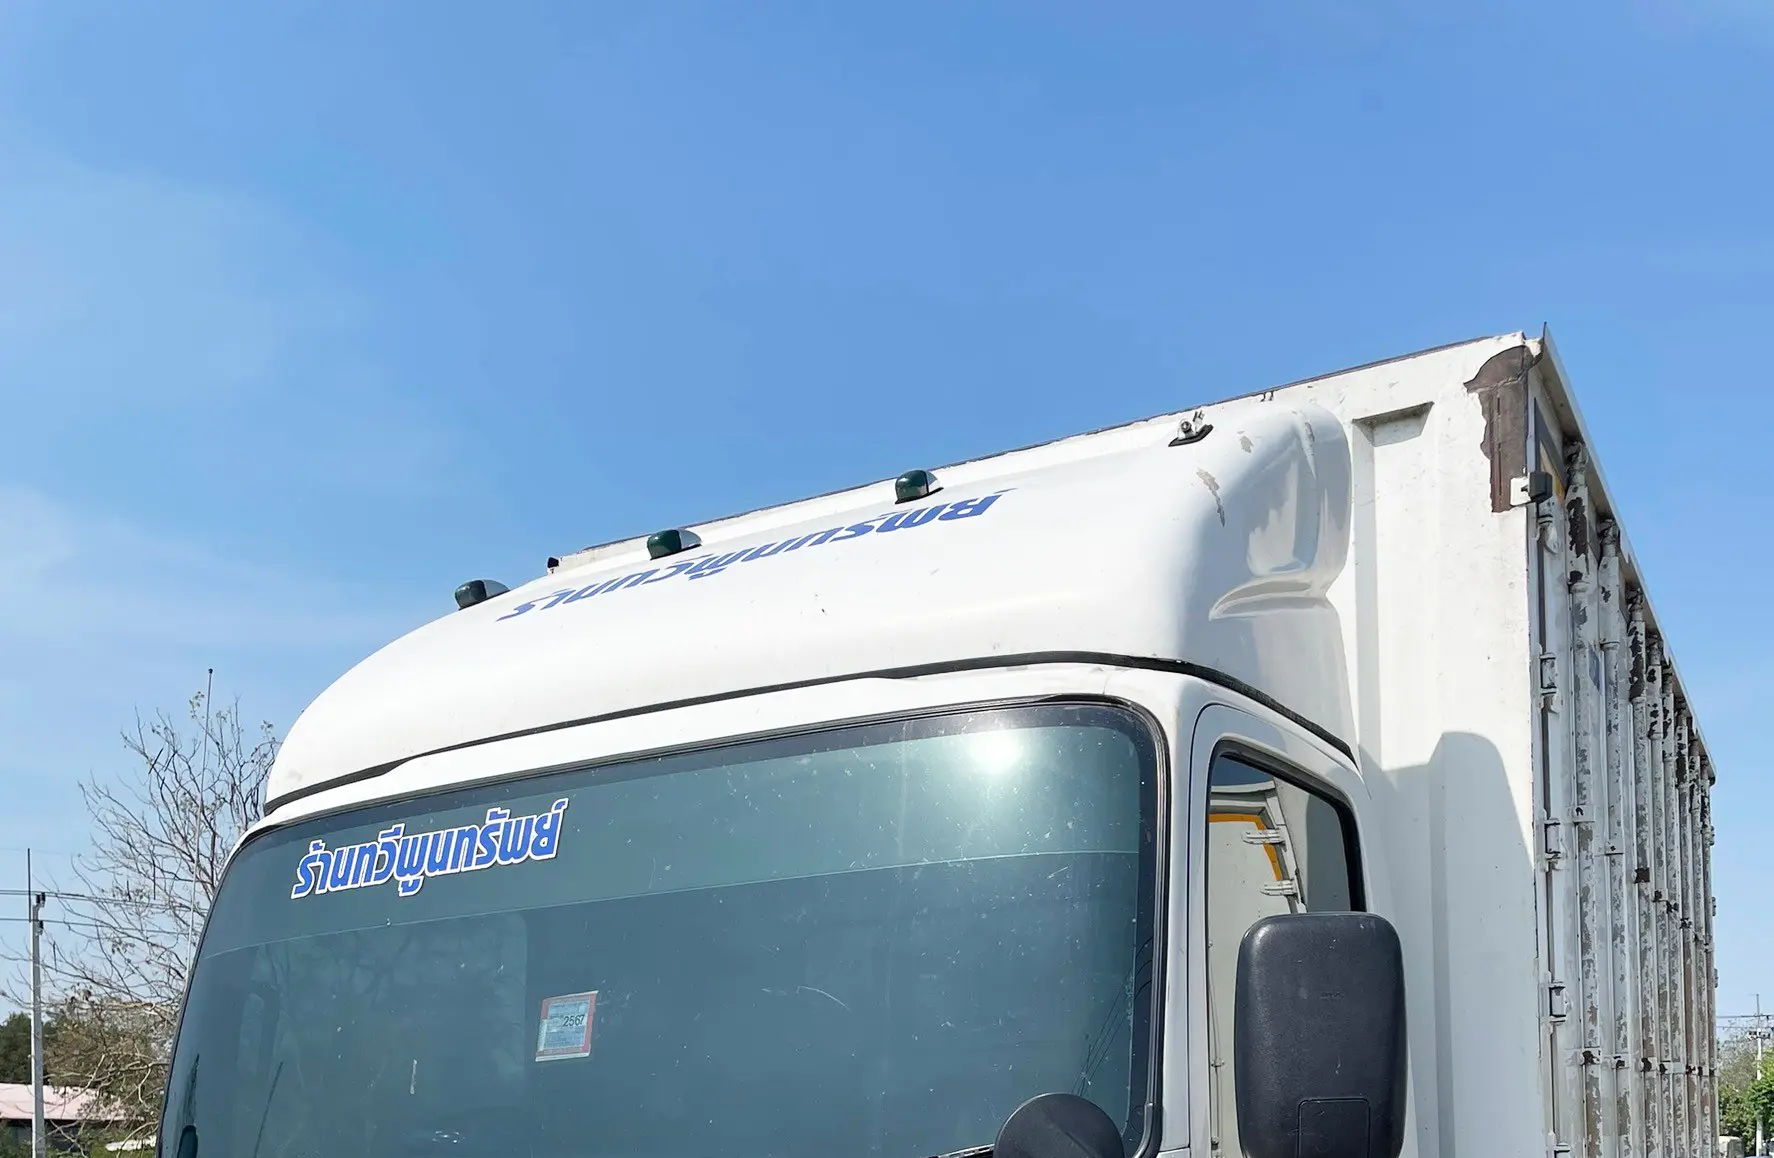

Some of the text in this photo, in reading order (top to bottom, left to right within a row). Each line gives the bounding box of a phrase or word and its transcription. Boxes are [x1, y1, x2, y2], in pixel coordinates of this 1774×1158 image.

[291, 798, 569, 899] ร้านทวีพูนทรัพย์
[563, 1015, 585, 1027] 2567
